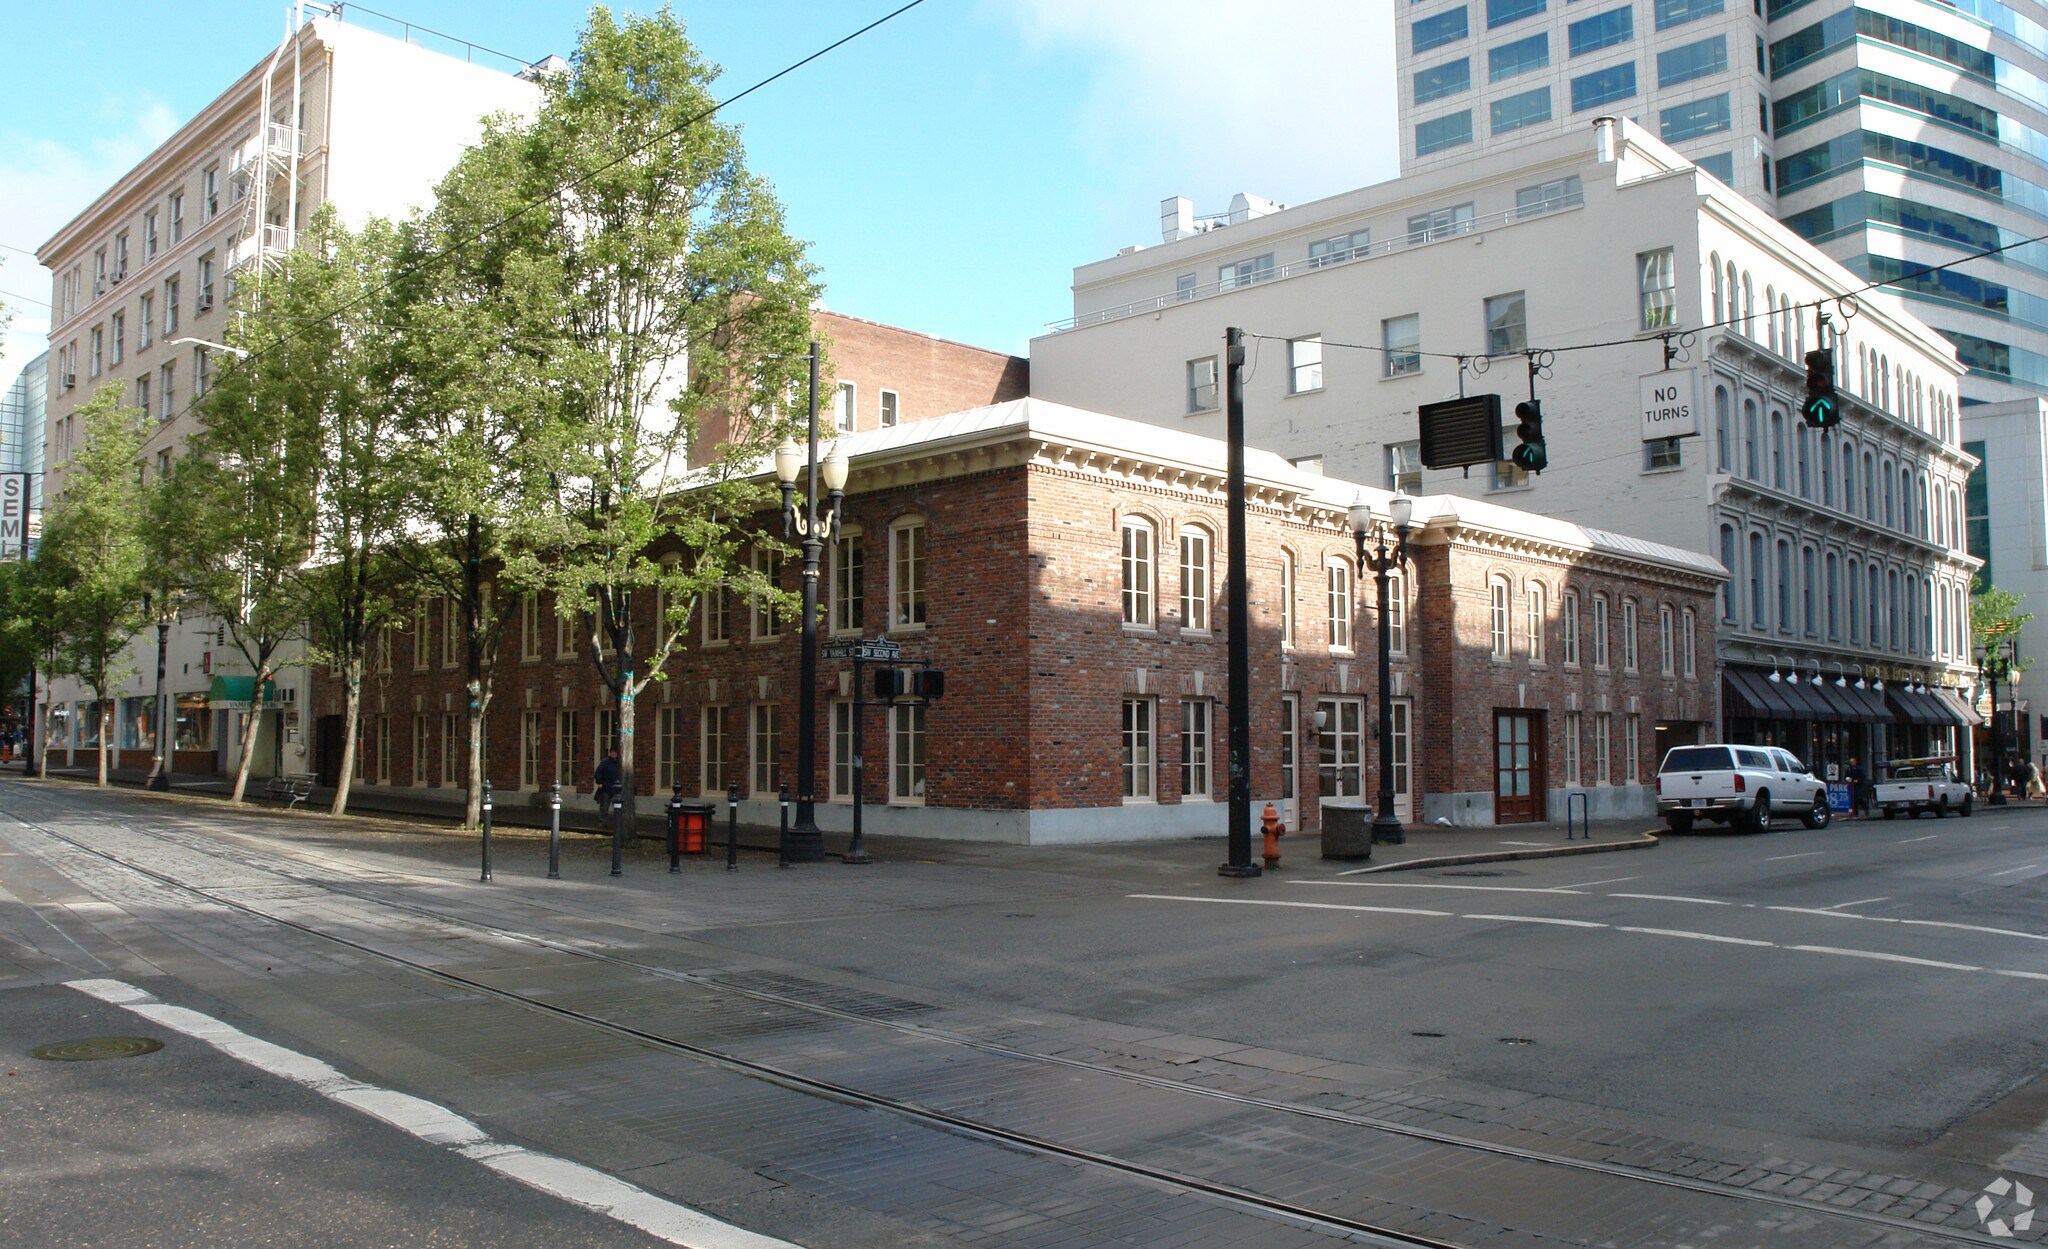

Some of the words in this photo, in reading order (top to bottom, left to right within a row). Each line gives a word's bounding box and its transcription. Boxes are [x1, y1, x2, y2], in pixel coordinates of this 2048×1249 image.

[1655, 386, 1677, 403] NO
[1645, 405, 1689, 423] TURNS
[864, 648, 871, 657] SW
[873, 648, 890, 658] SECOND
[891, 649, 900, 659] AVE
[1830, 783, 1848, 792] PARK
